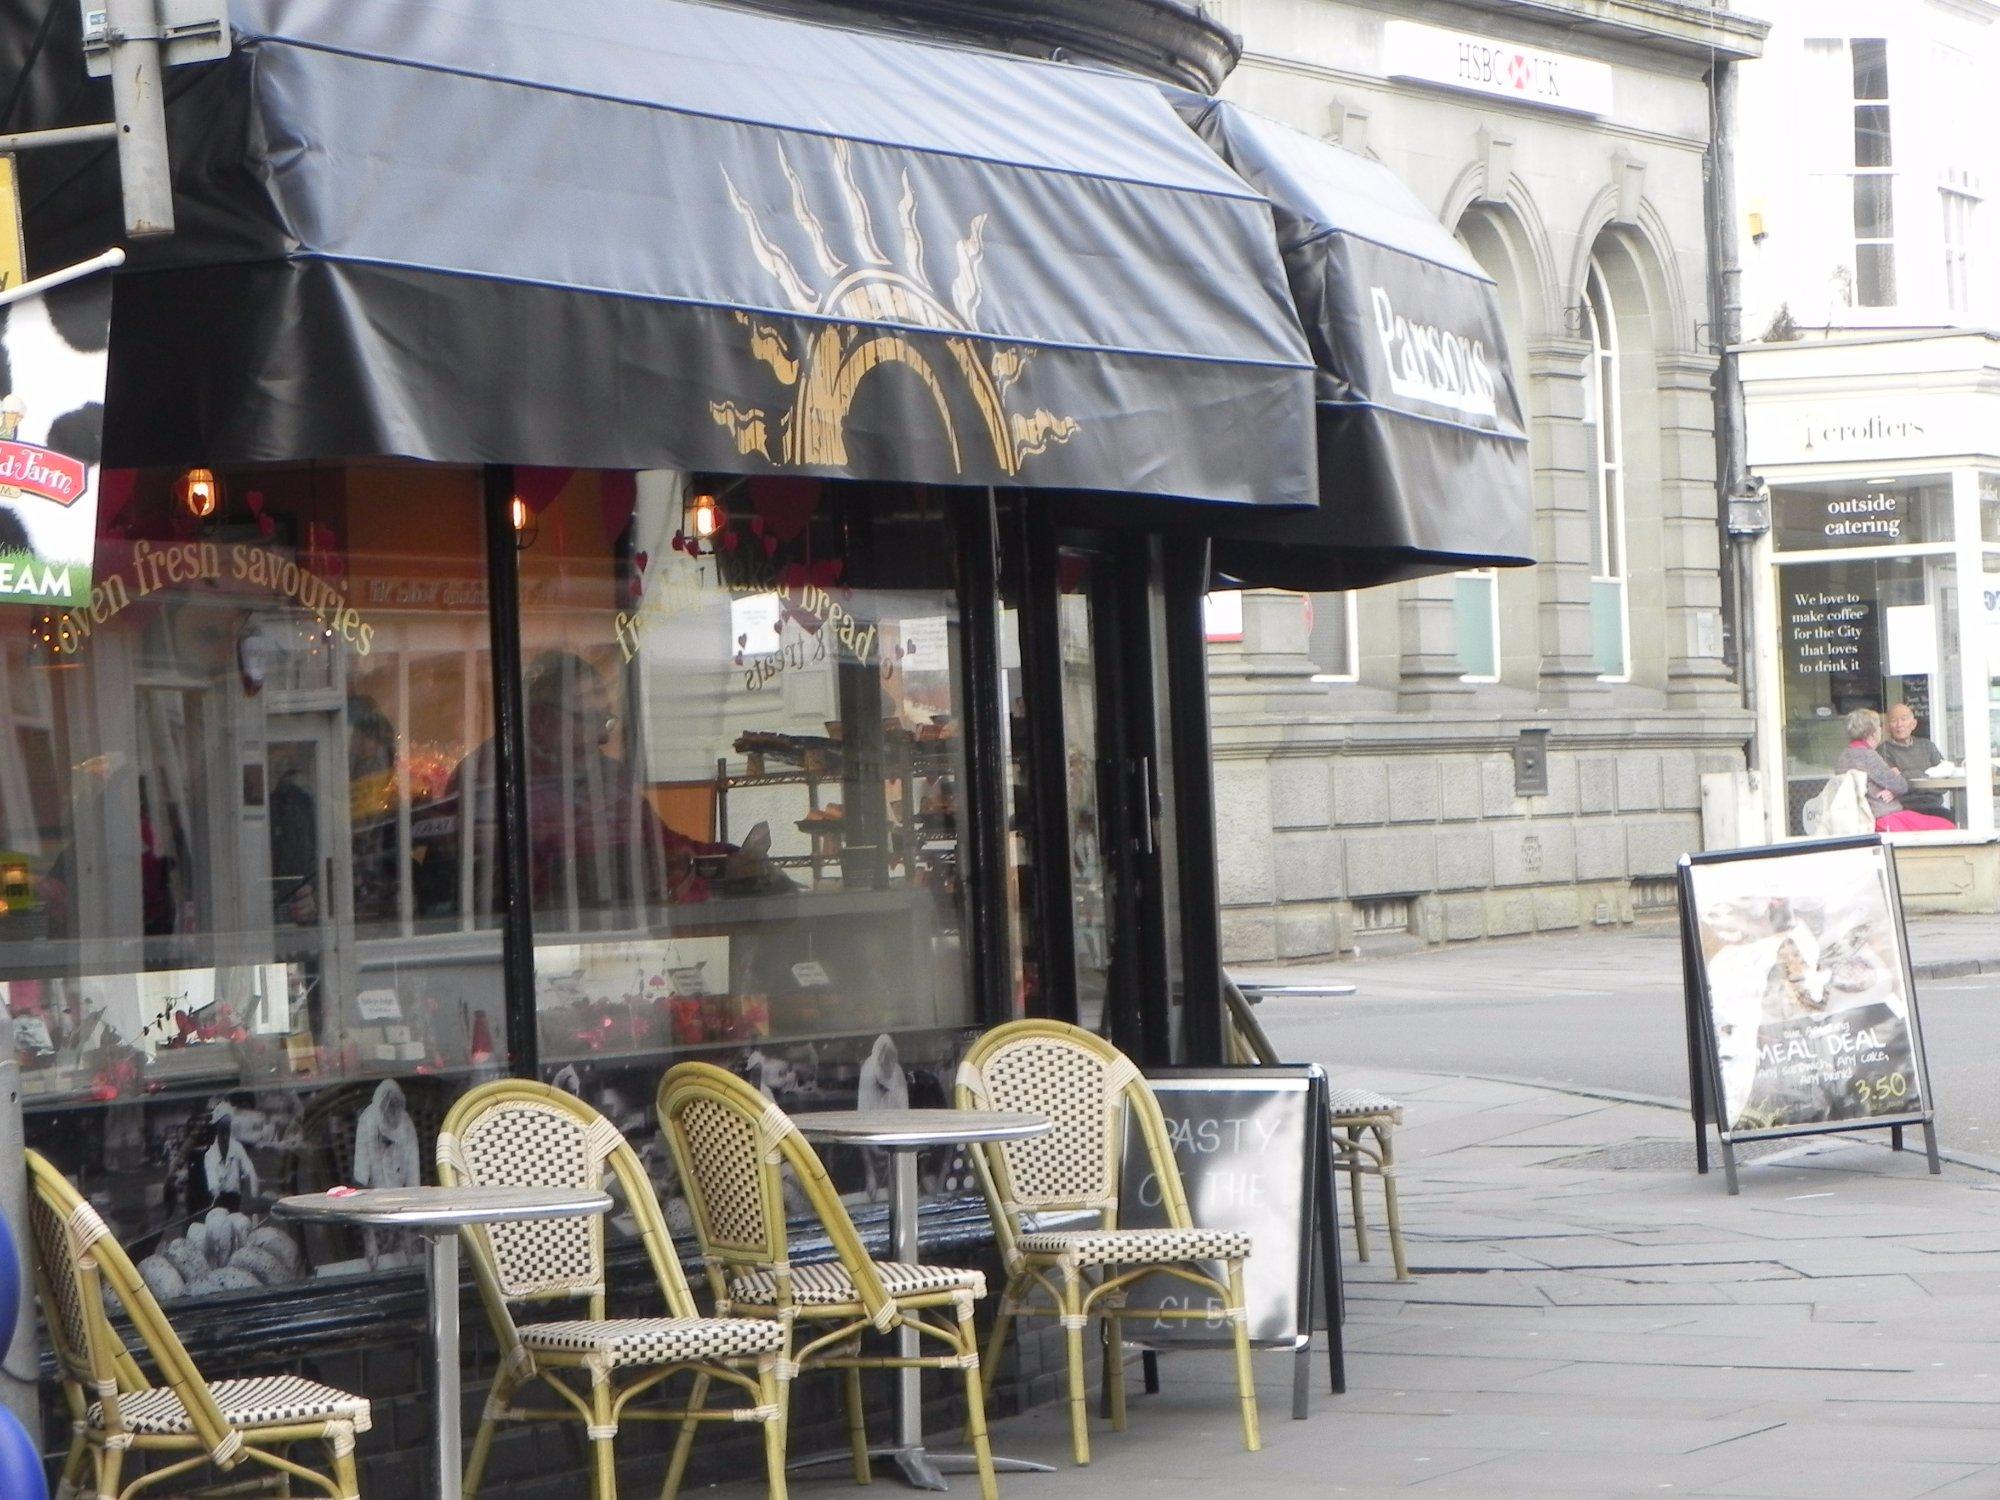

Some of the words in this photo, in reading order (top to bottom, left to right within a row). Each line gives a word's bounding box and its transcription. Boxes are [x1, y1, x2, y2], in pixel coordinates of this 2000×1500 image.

[1458, 42, 1504, 86] HSBC
[1534, 58, 1559, 97] UK
[1370, 286, 1496, 412] Parsons
[14, 449, 73, 494] Farm
[1827, 493, 1896, 515] outside
[1824, 516, 1901, 538] catering
[57, 573, 130, 655] oven
[133, 539, 220, 597] fresh
[232, 542, 375, 657] savouries
[1792, 609, 1824, 623] make
[1826, 607, 1864, 621] coffee
[1794, 593, 1816, 606] We
[1819, 592, 1844, 605] love
[1847, 593, 1860, 604] to
[799, 578, 877, 667] bread
[1793, 627, 1812, 640] for
[1814, 626, 1835, 639] the
[1837, 625, 1862, 640] City
[1799, 662, 1812, 673] to
[1814, 659, 1848, 673] drink
[1851, 658, 1860, 671] it
[1800, 643, 1825, 656] that
[1827, 642, 1859, 655] loves
[1756, 1037, 1818, 1067] MEAL
[1826, 1027, 1887, 1055] DEAL
[1855, 1071, 1907, 1104] 3.50
[1164, 1118, 1282, 1154] PASTY
[1205, 1171, 1267, 1207] THE
